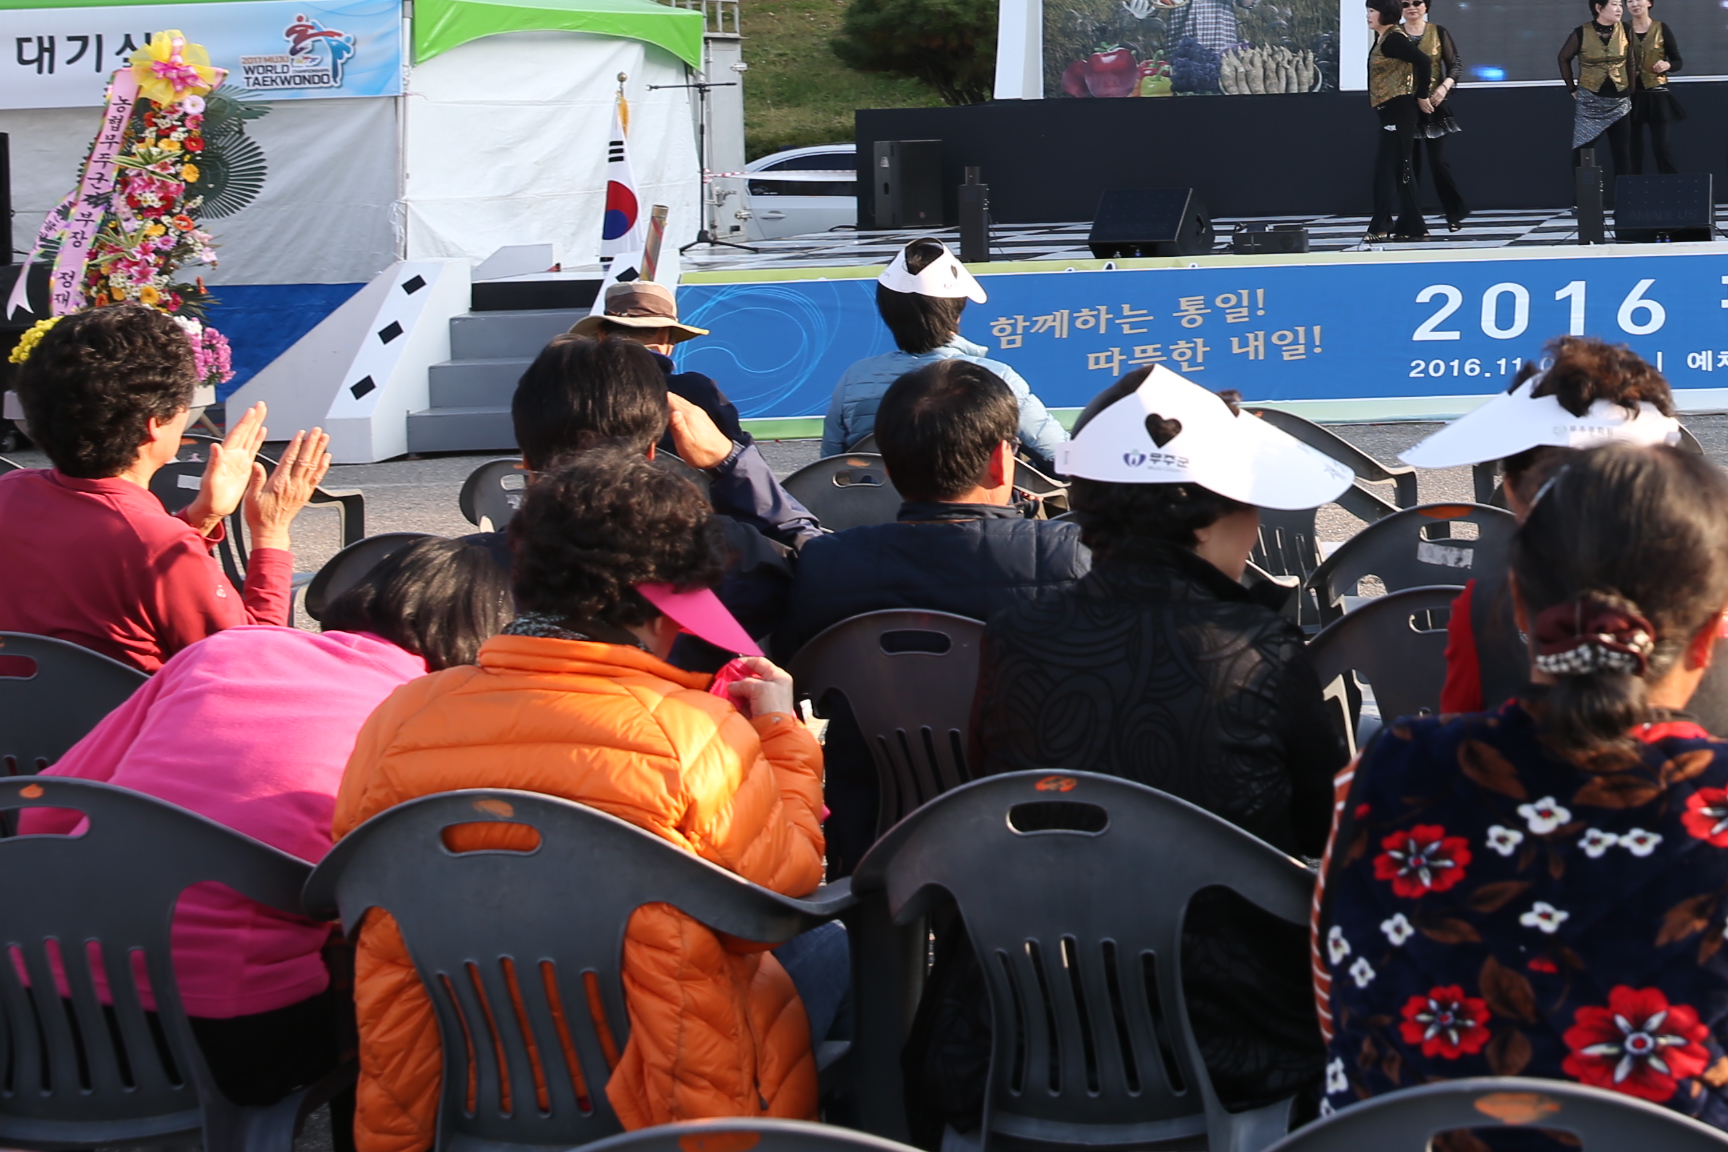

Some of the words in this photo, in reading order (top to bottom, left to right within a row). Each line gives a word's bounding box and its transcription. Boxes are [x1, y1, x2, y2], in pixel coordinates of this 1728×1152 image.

[243, 64, 290, 75] WORLD
[244, 74, 331, 87] TAEKWONDO
[53, 270, 77, 317] 정재
[1412, 278, 1668, 341] 2016
[990, 304, 1154, 351] 함께하는
[1172, 287, 1266, 329] 통일!
[1086, 337, 1210, 378] 따뜻한
[1229, 325, 1323, 362] 내일!
[1149, 452, 1190, 469] 무주군
